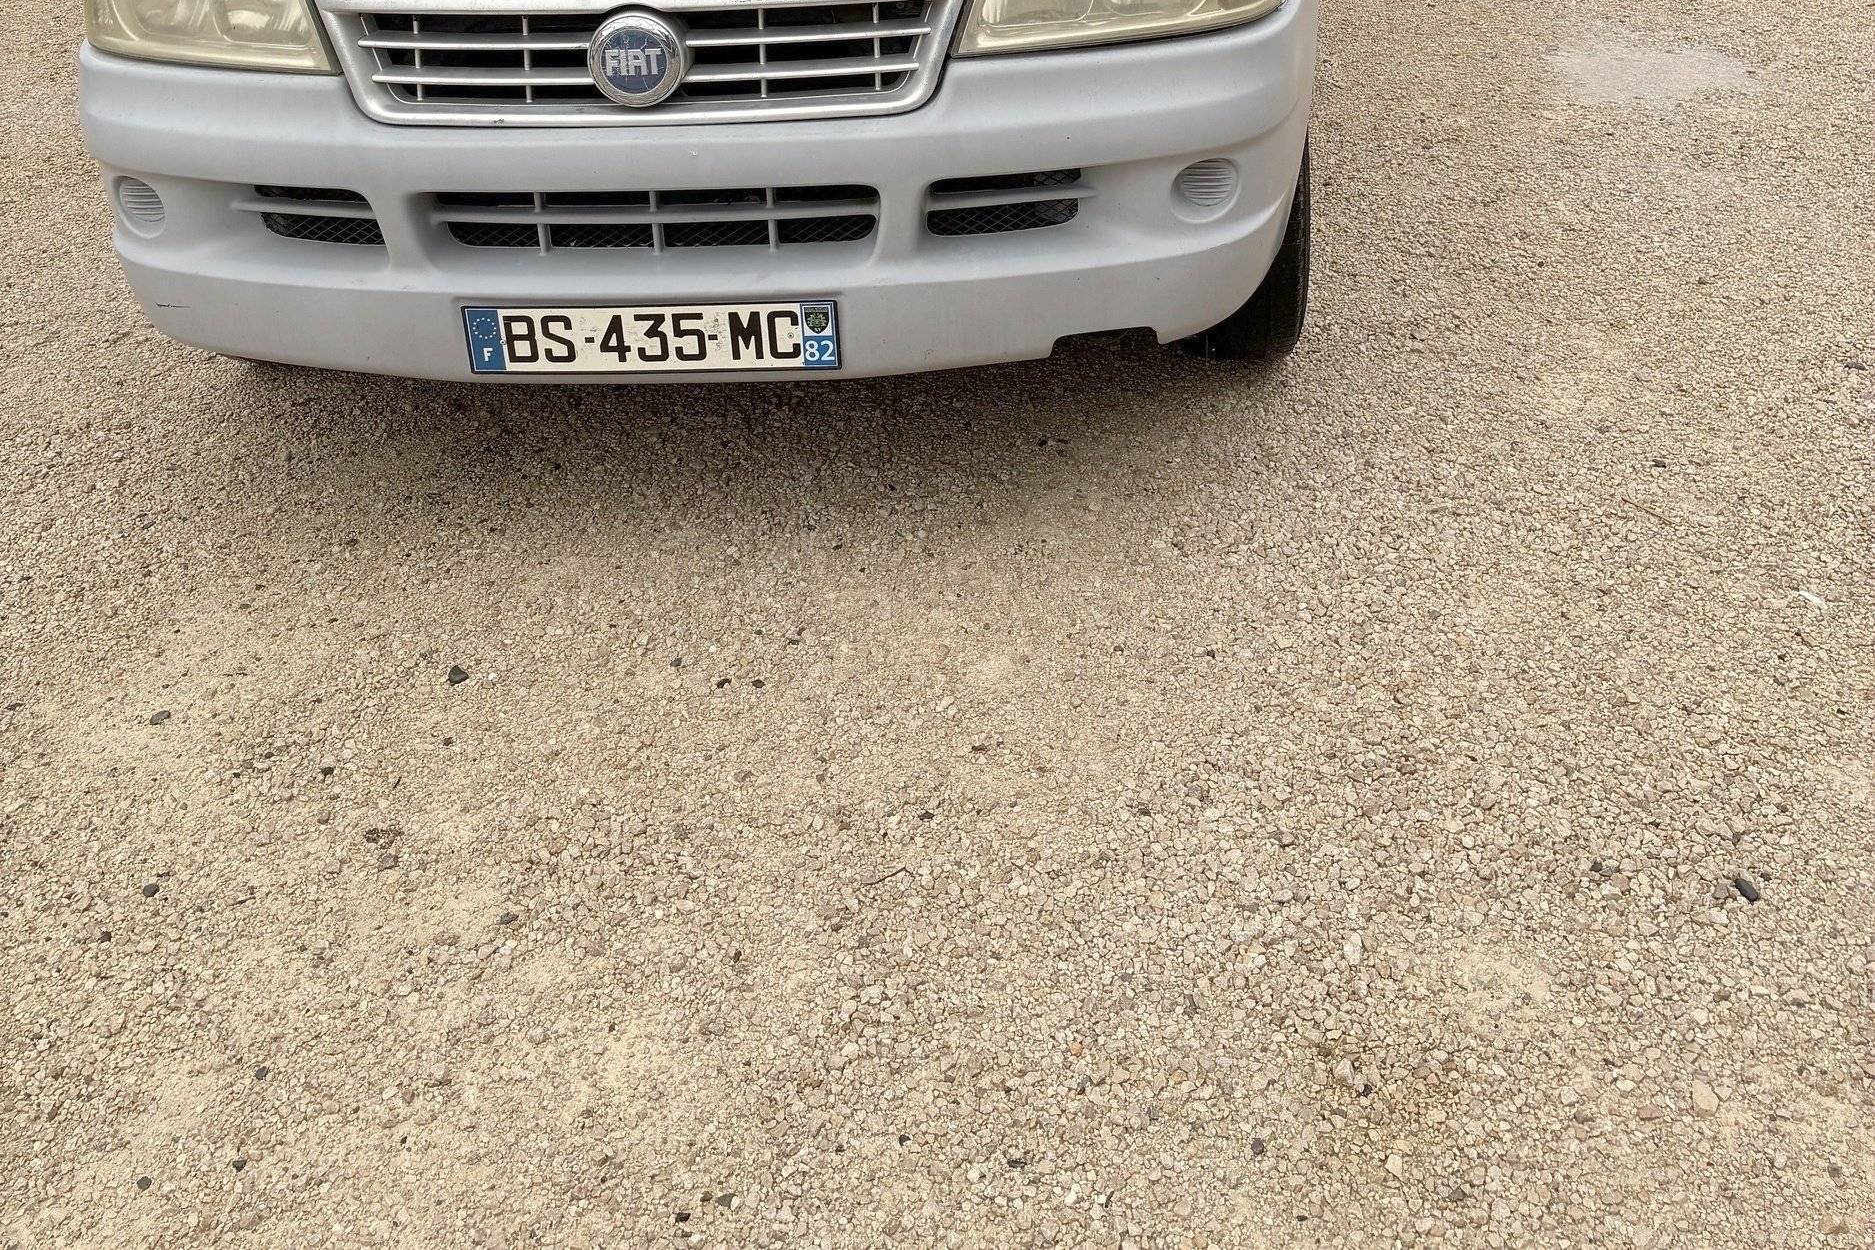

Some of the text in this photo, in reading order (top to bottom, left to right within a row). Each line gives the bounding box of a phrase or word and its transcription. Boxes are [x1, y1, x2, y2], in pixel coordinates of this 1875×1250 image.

[604, 47, 663, 77] FIAT
[502, 310, 802, 364] BS-435-MC
[483, 347, 494, 362] F
[805, 340, 835, 361] 82
